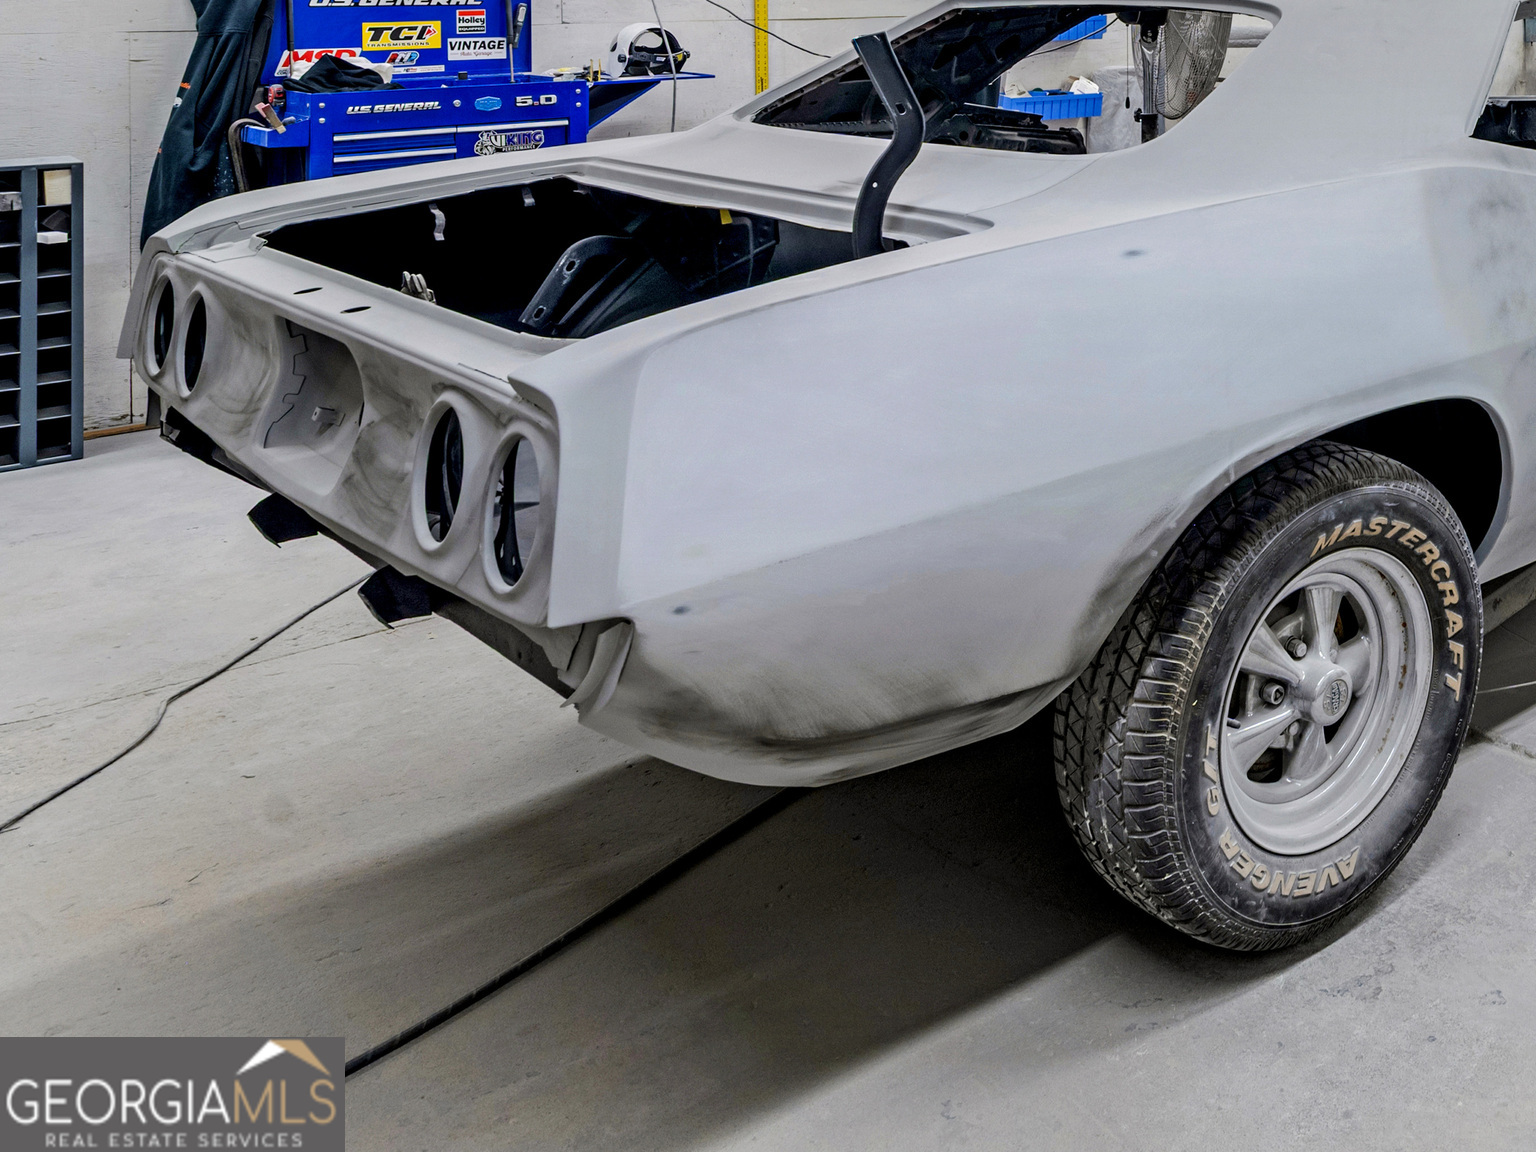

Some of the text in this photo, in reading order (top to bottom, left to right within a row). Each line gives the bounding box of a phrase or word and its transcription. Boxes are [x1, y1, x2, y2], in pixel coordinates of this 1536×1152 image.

[458, 17, 485, 26] Holley
[367, 26, 431, 42] TCI
[449, 40, 505, 50] VINTAGE
[372, 101, 442, 113] GENERAL
[515, 94, 558, 107] 5.0
[490, 132, 542, 147] VIKING
[1310, 517, 1463, 702] MASTERCRAFT
[1219, 829, 1360, 899] AVENGER
